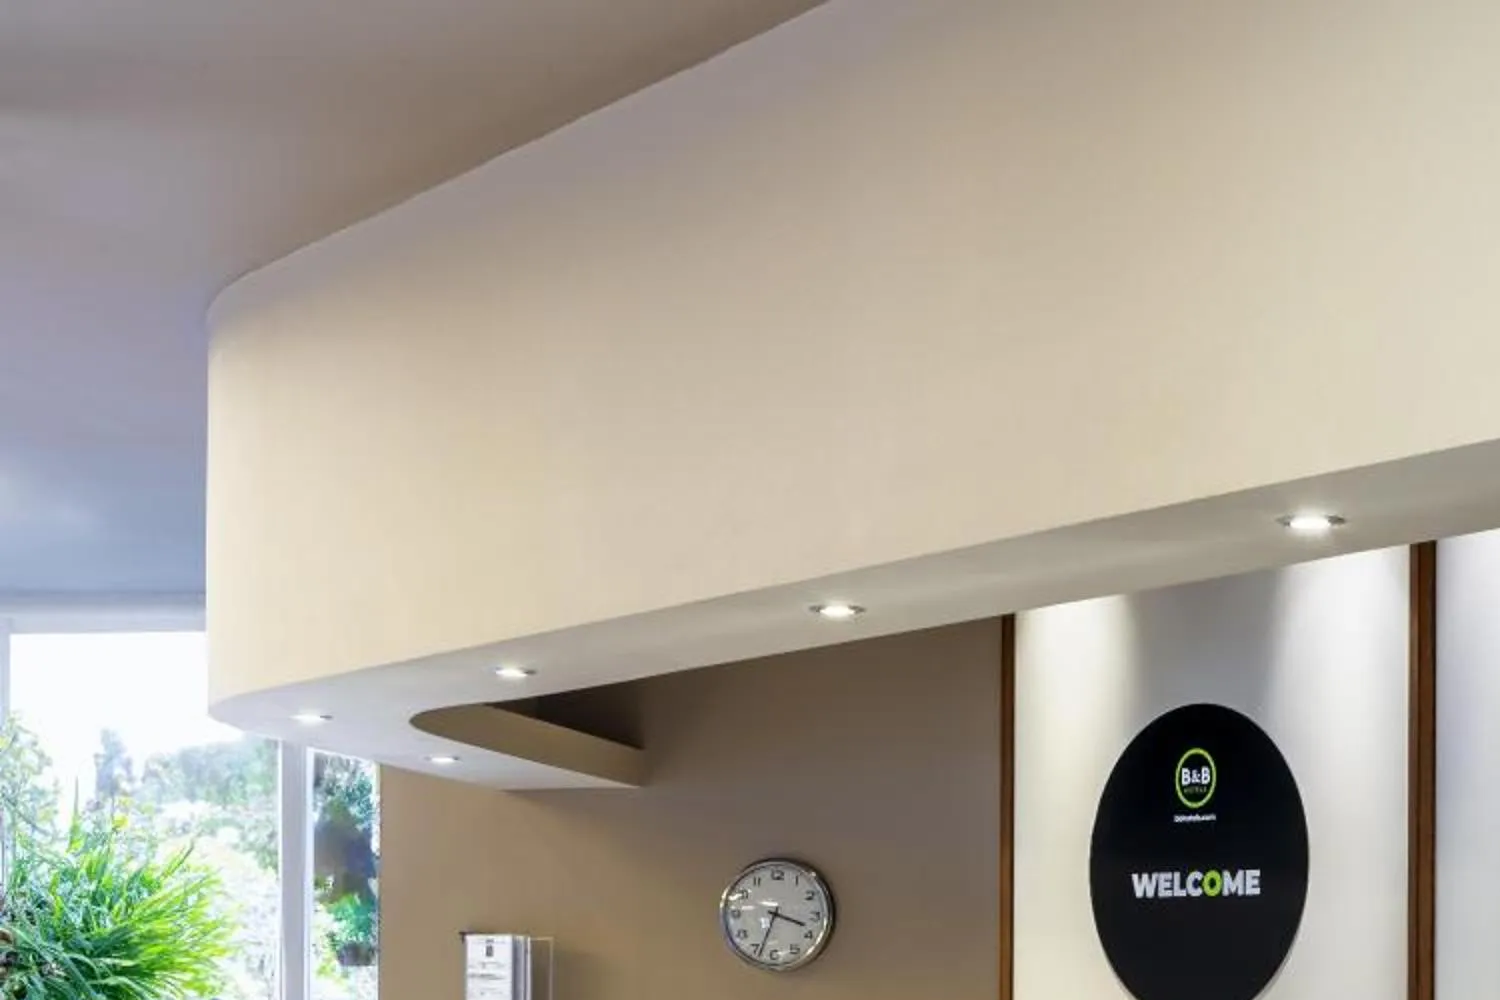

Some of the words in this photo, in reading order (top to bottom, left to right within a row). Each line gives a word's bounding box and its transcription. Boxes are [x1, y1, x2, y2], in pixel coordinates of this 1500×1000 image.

[1181, 766, 1211, 786] B&B
[770, 869, 785, 881] 12
[1131, 869, 1261, 899] WELCOME
[805, 890, 815, 901] 2
[804, 930, 813, 940] 4
[790, 944, 800, 955] 5
